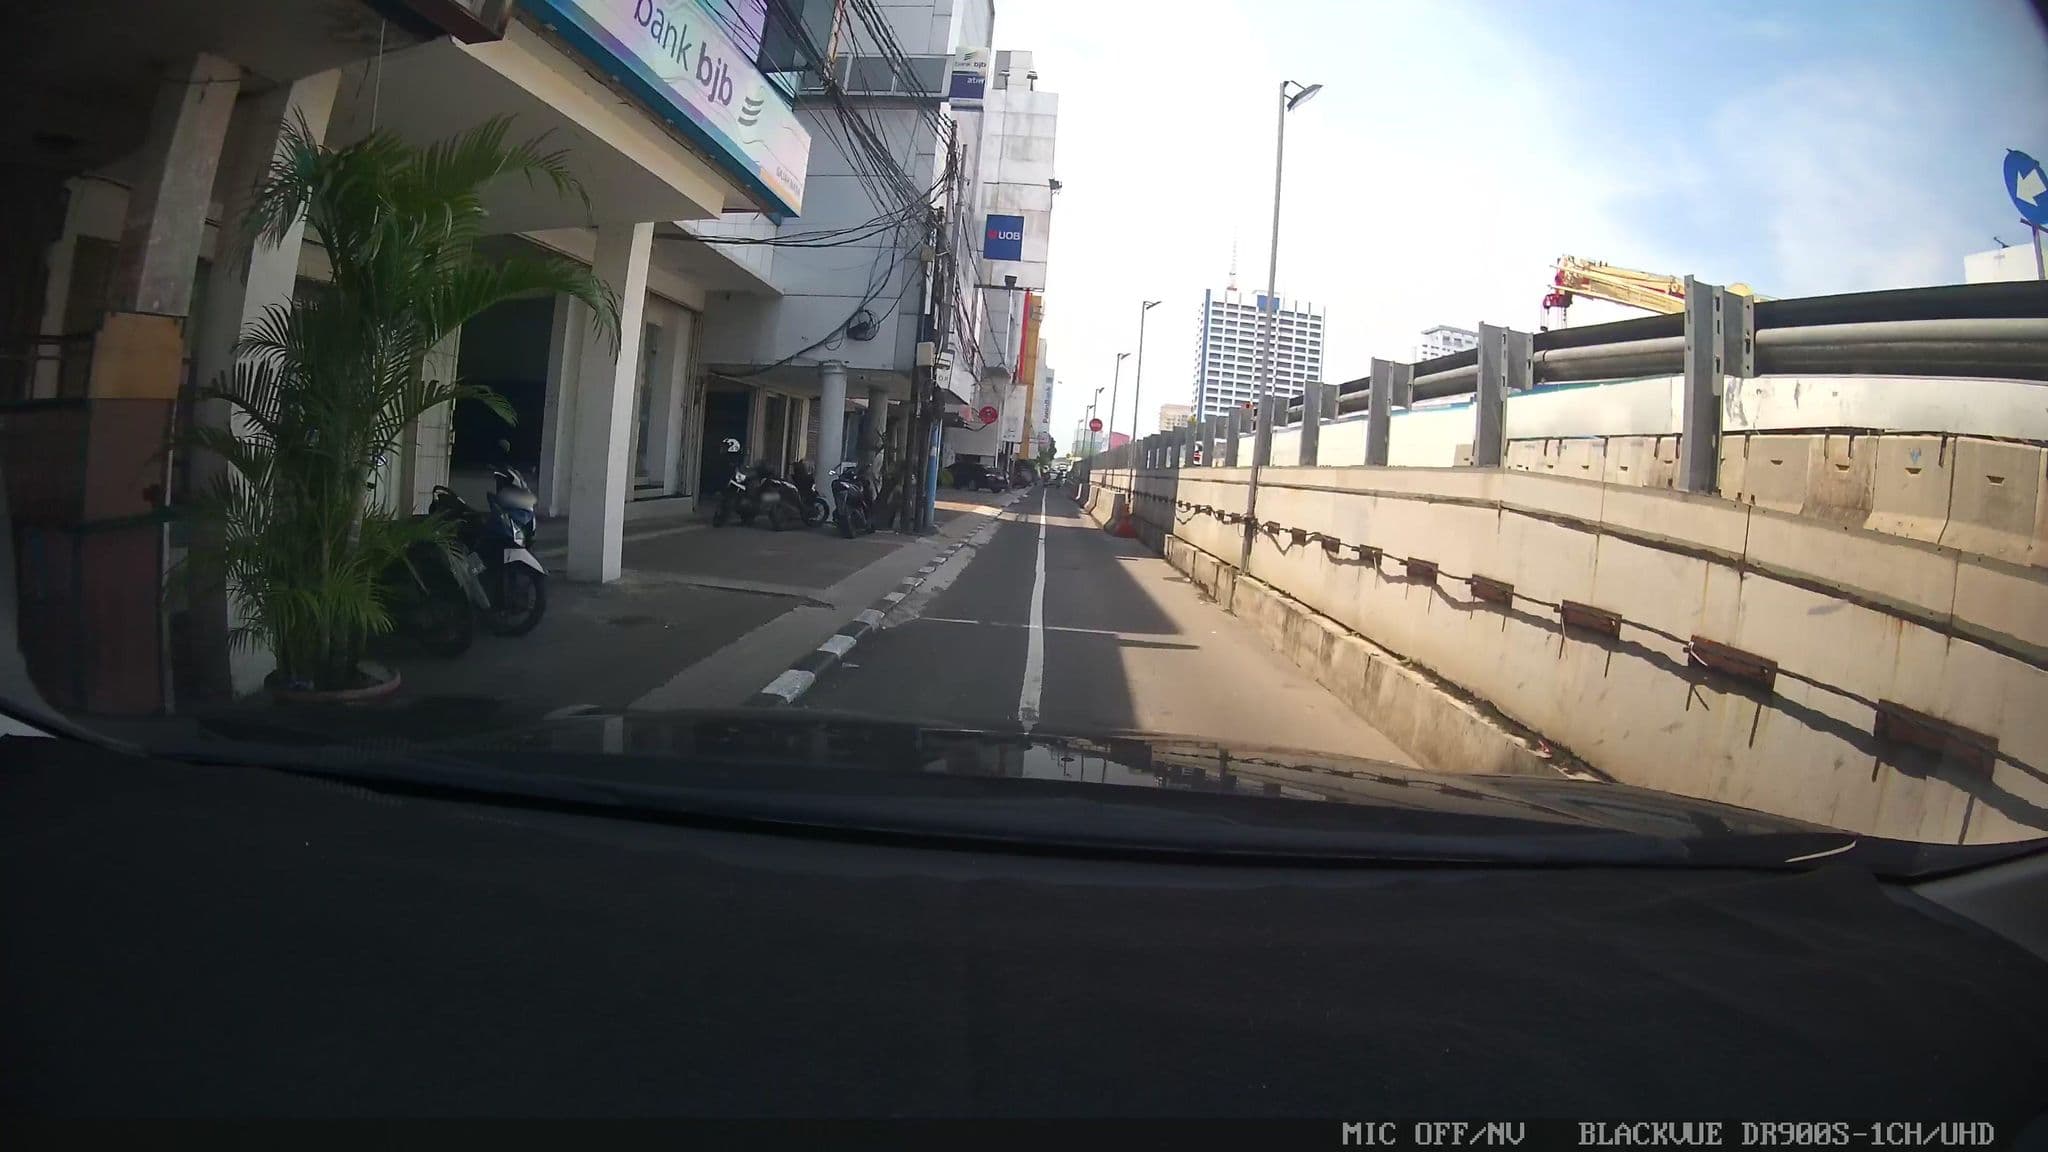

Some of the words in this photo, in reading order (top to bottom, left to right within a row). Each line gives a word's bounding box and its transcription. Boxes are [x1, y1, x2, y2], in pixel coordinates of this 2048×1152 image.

[634, 0, 692, 71] bank
[696, 41, 733, 106] bjb
[998, 231, 1021, 240] UOB
